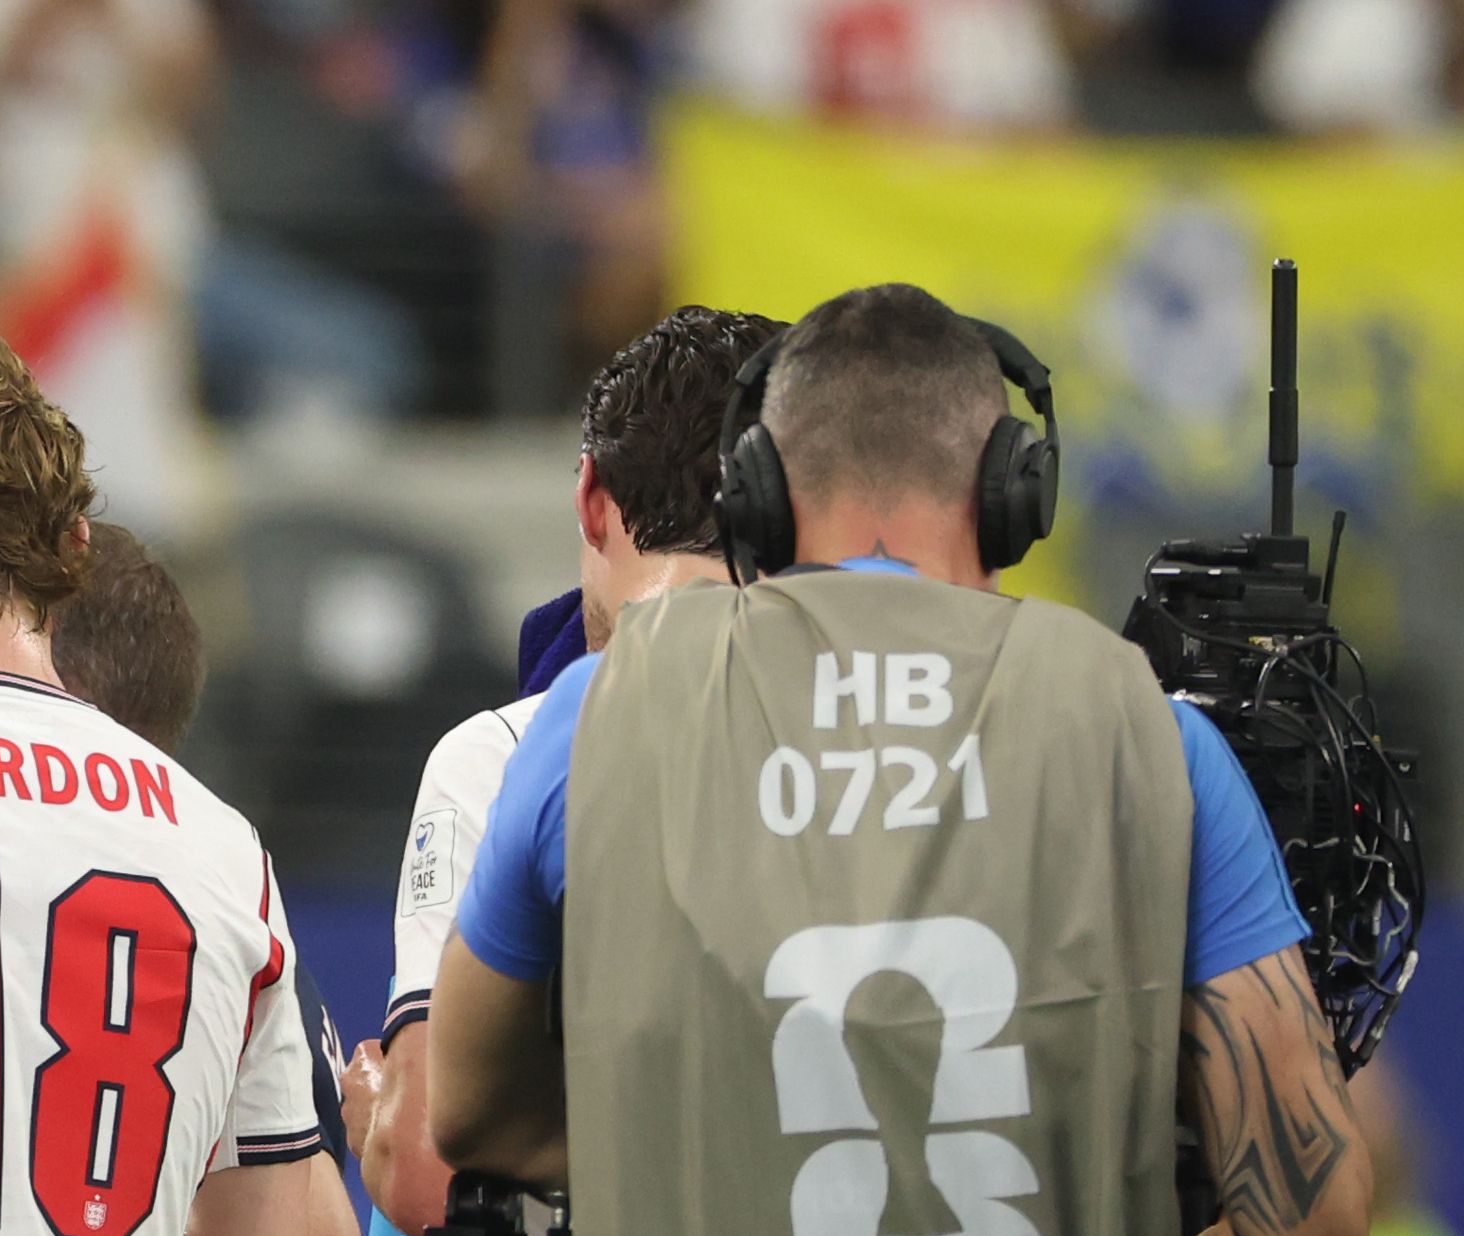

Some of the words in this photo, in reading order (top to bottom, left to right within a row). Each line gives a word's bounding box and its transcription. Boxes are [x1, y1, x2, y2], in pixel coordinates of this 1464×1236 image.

[812, 650, 955, 729] HB
[758, 733, 990, 837] 0721
[410, 869, 436, 892] EACE
